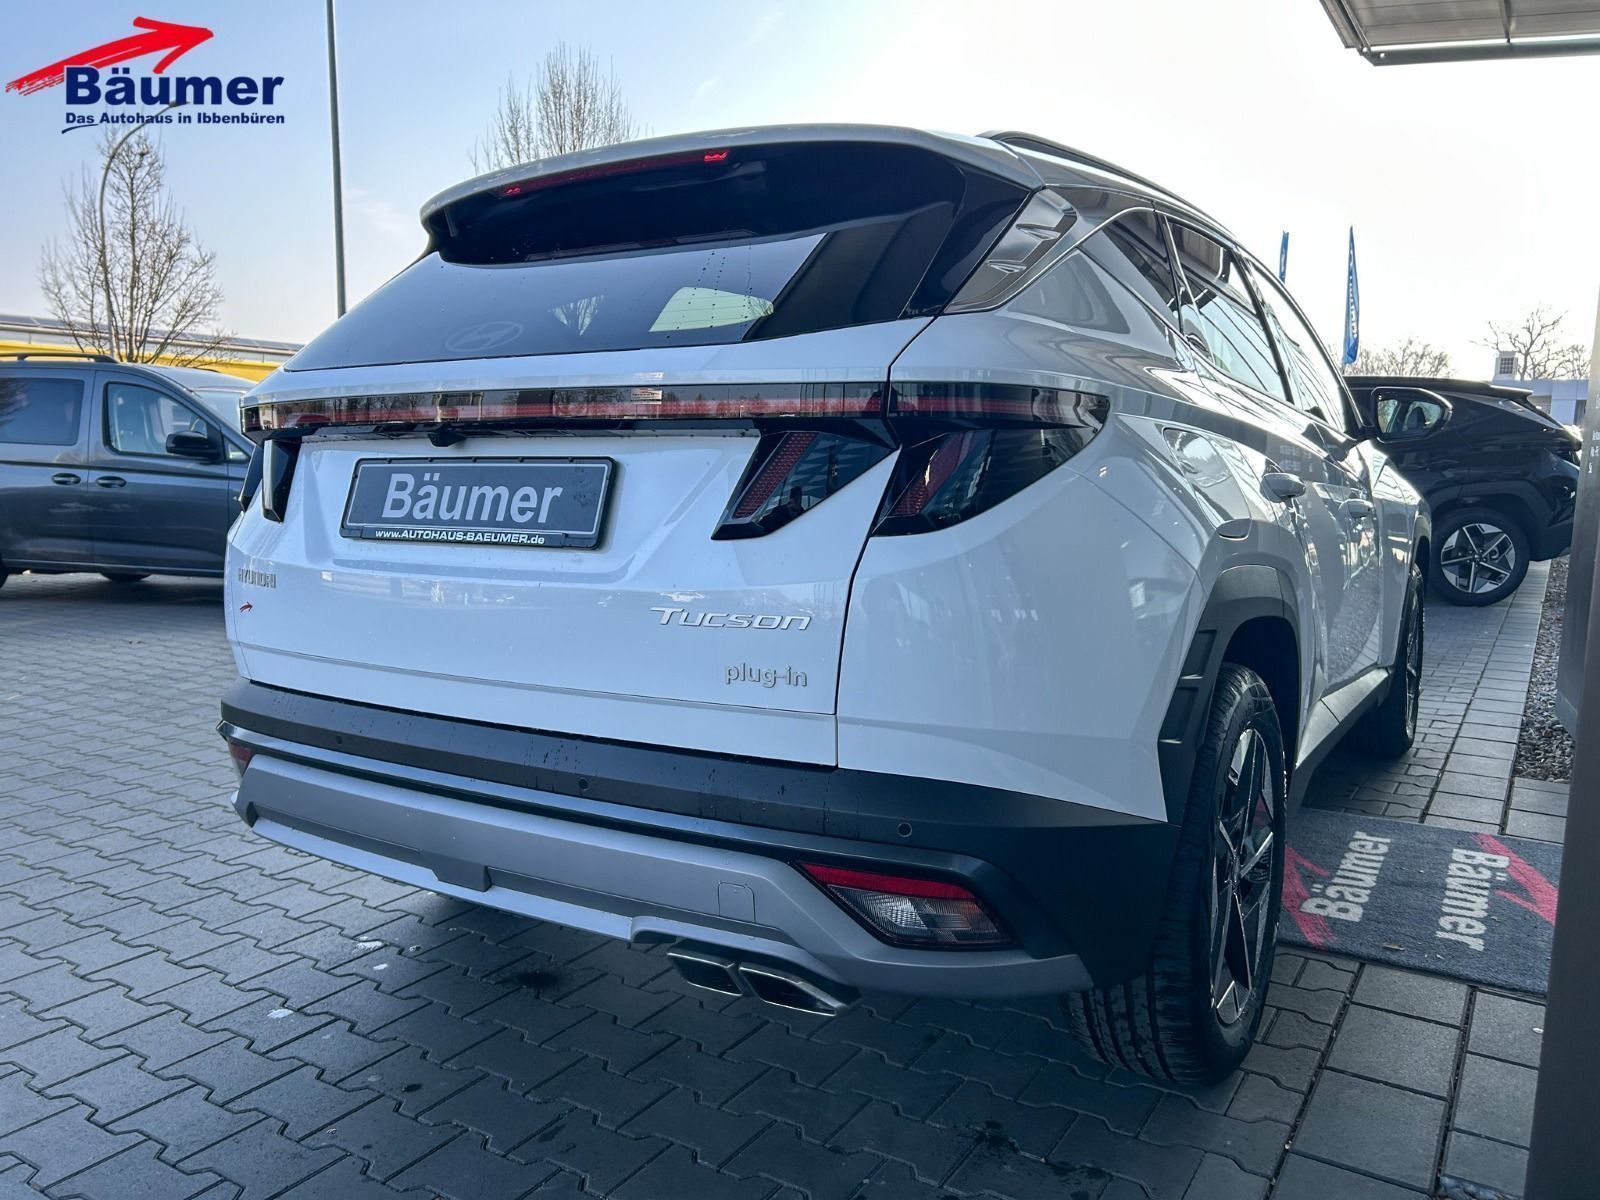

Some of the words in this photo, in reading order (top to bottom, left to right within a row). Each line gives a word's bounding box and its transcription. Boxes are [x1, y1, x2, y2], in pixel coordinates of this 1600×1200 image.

[381, 472, 563, 523] Bäumer
[375, 529, 545, 545] www.AUTOHAUS-BAEUMER.de
[238, 567, 277, 589] HYUNDAI
[725, 662, 808, 688] plug-in
[1300, 830, 1392, 922] Bäumer
[1435, 848, 1510, 951] Bäumer
